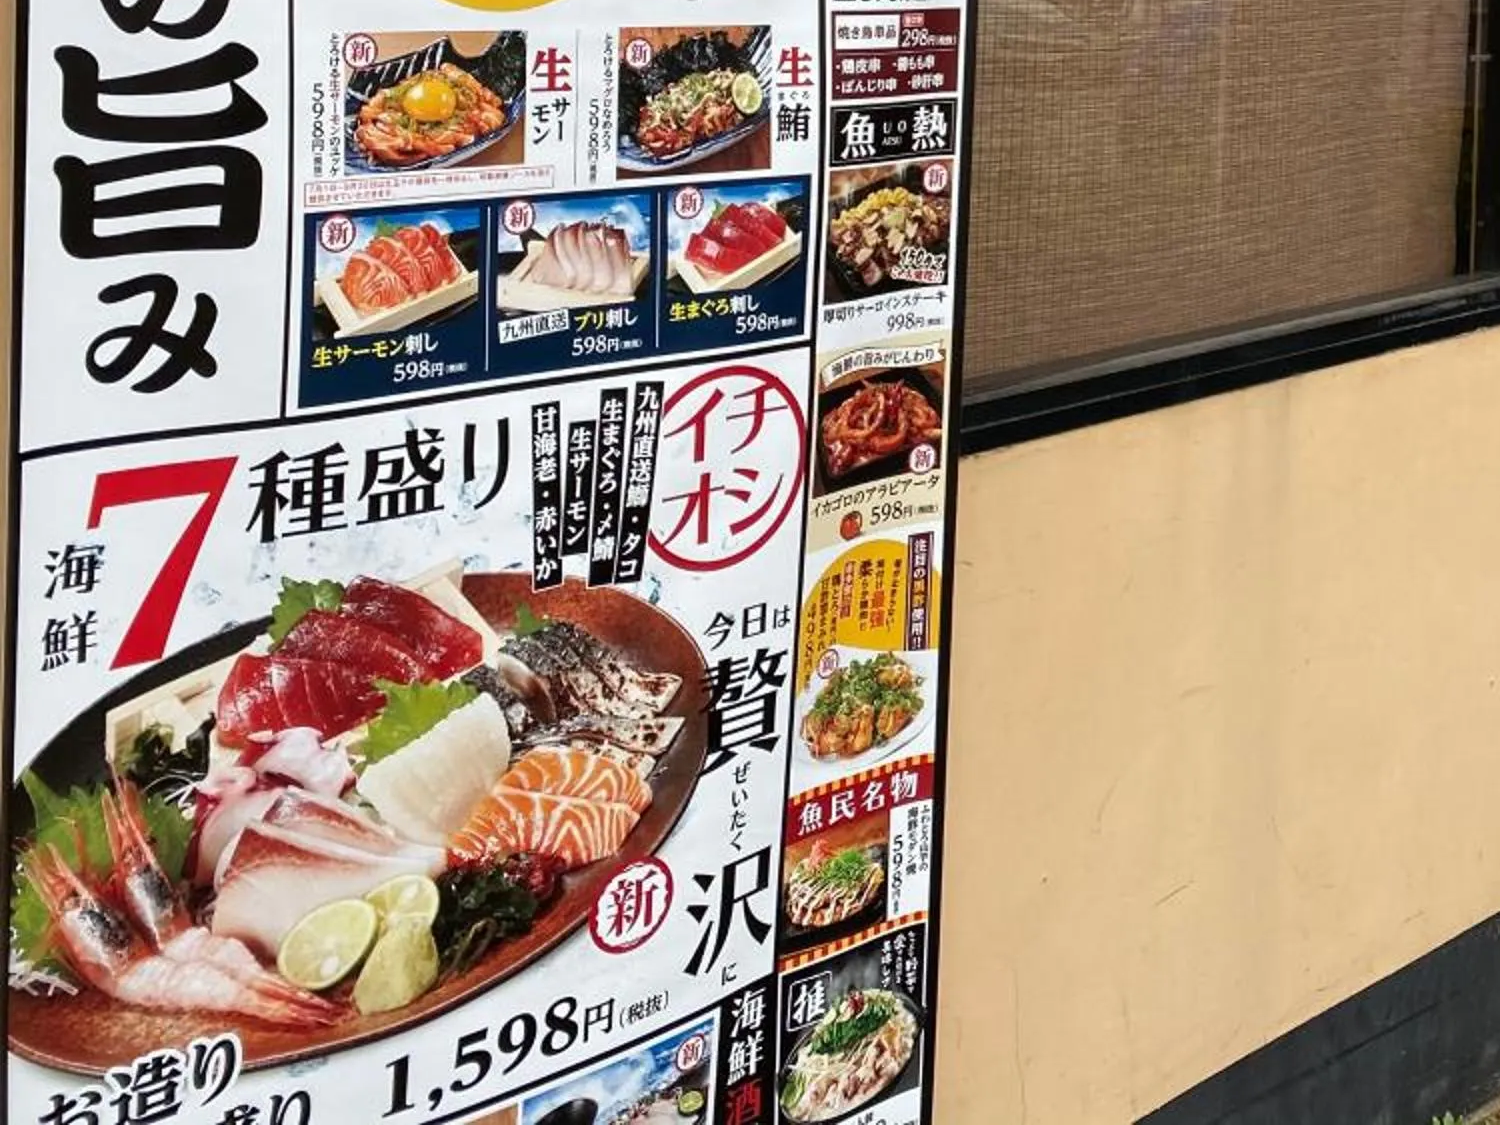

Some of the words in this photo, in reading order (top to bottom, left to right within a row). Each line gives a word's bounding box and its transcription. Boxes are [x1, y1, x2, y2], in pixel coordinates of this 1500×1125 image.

[502, 309, 568, 340] 九州直送
[669, 295, 760, 321] 生まぐろ刺し
[312, 333, 439, 369] 生サーモン刺し
[567, 428, 592, 546] 生サーモン
[812, 474, 940, 518] イカゴロのアラビアータ
[799, 771, 919, 835] 魚民名物
